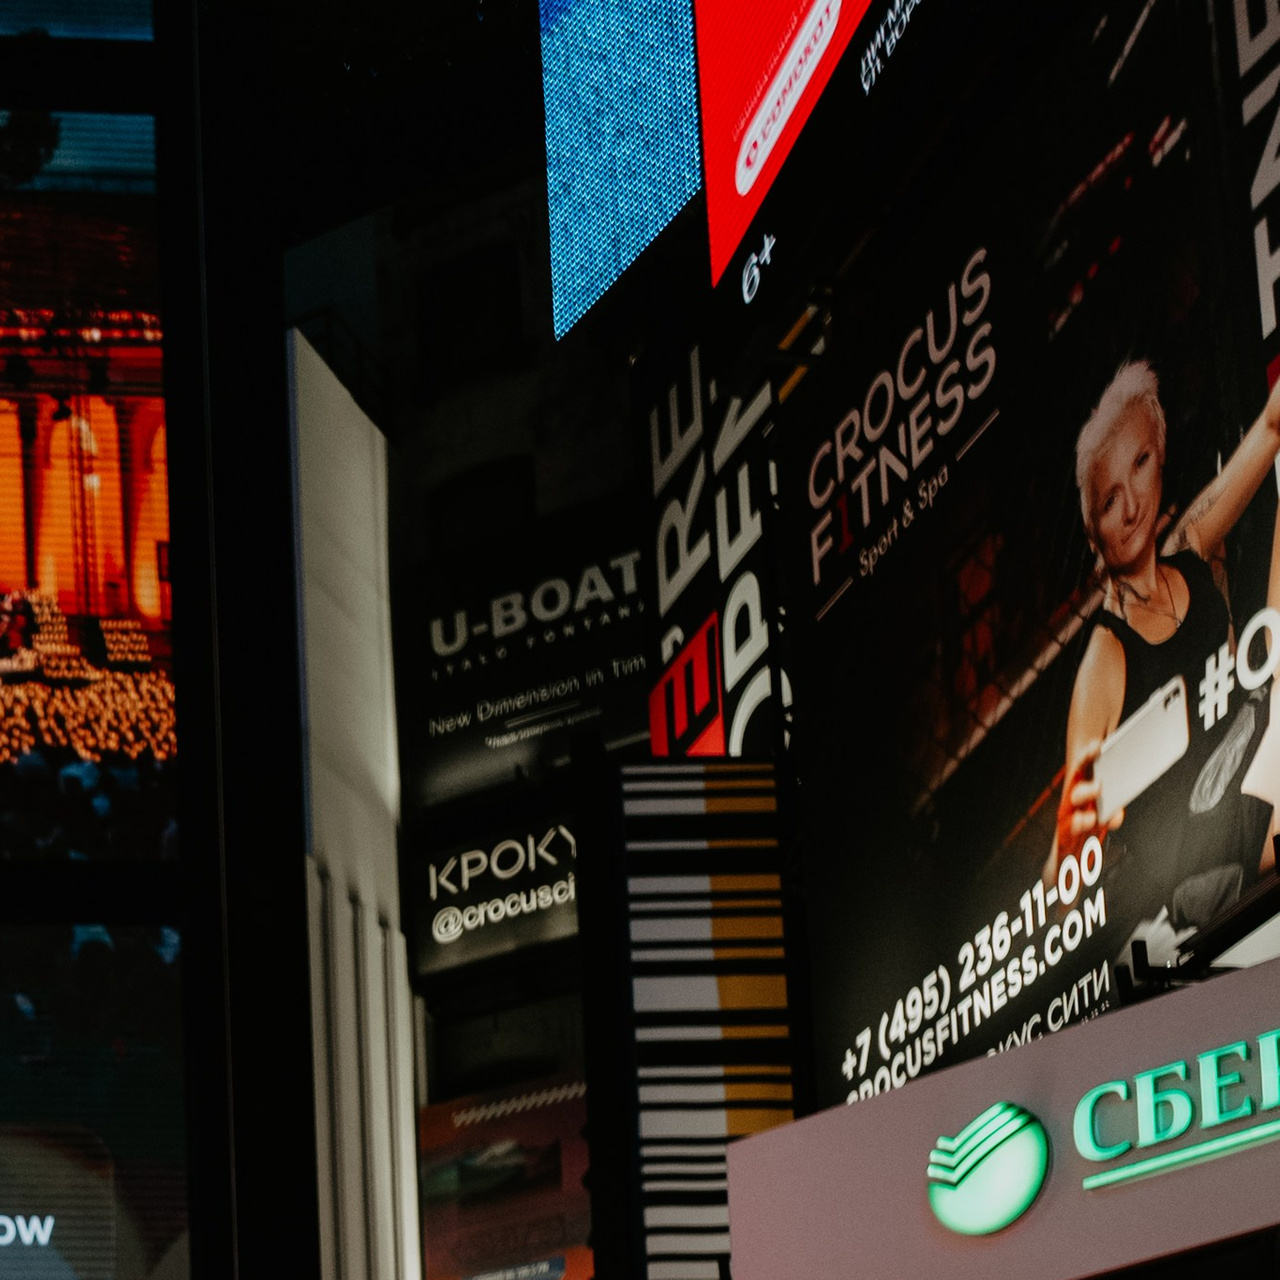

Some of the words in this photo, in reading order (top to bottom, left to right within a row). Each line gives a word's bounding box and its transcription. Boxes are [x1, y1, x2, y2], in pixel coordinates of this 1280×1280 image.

[741, 234, 776, 304] 6+
[808, 246, 992, 508] CROCUS
[809, 321, 997, 585] FITNESS
[859, 515, 898, 577] Sport
[901, 499, 915, 529] &
[918, 464, 949, 513] Spa
[429, 549, 642, 657] U-BOAT
[429, 710, 472, 738] New
[476, 676, 581, 725] Dimension
[586, 665, 605, 688] in
[842, 1026, 871, 1081] +7
[878, 964, 951, 1062] (495)
[957, 835, 1104, 992] 236-11-00
[1047, 960, 1110, 1033] СИТИ
